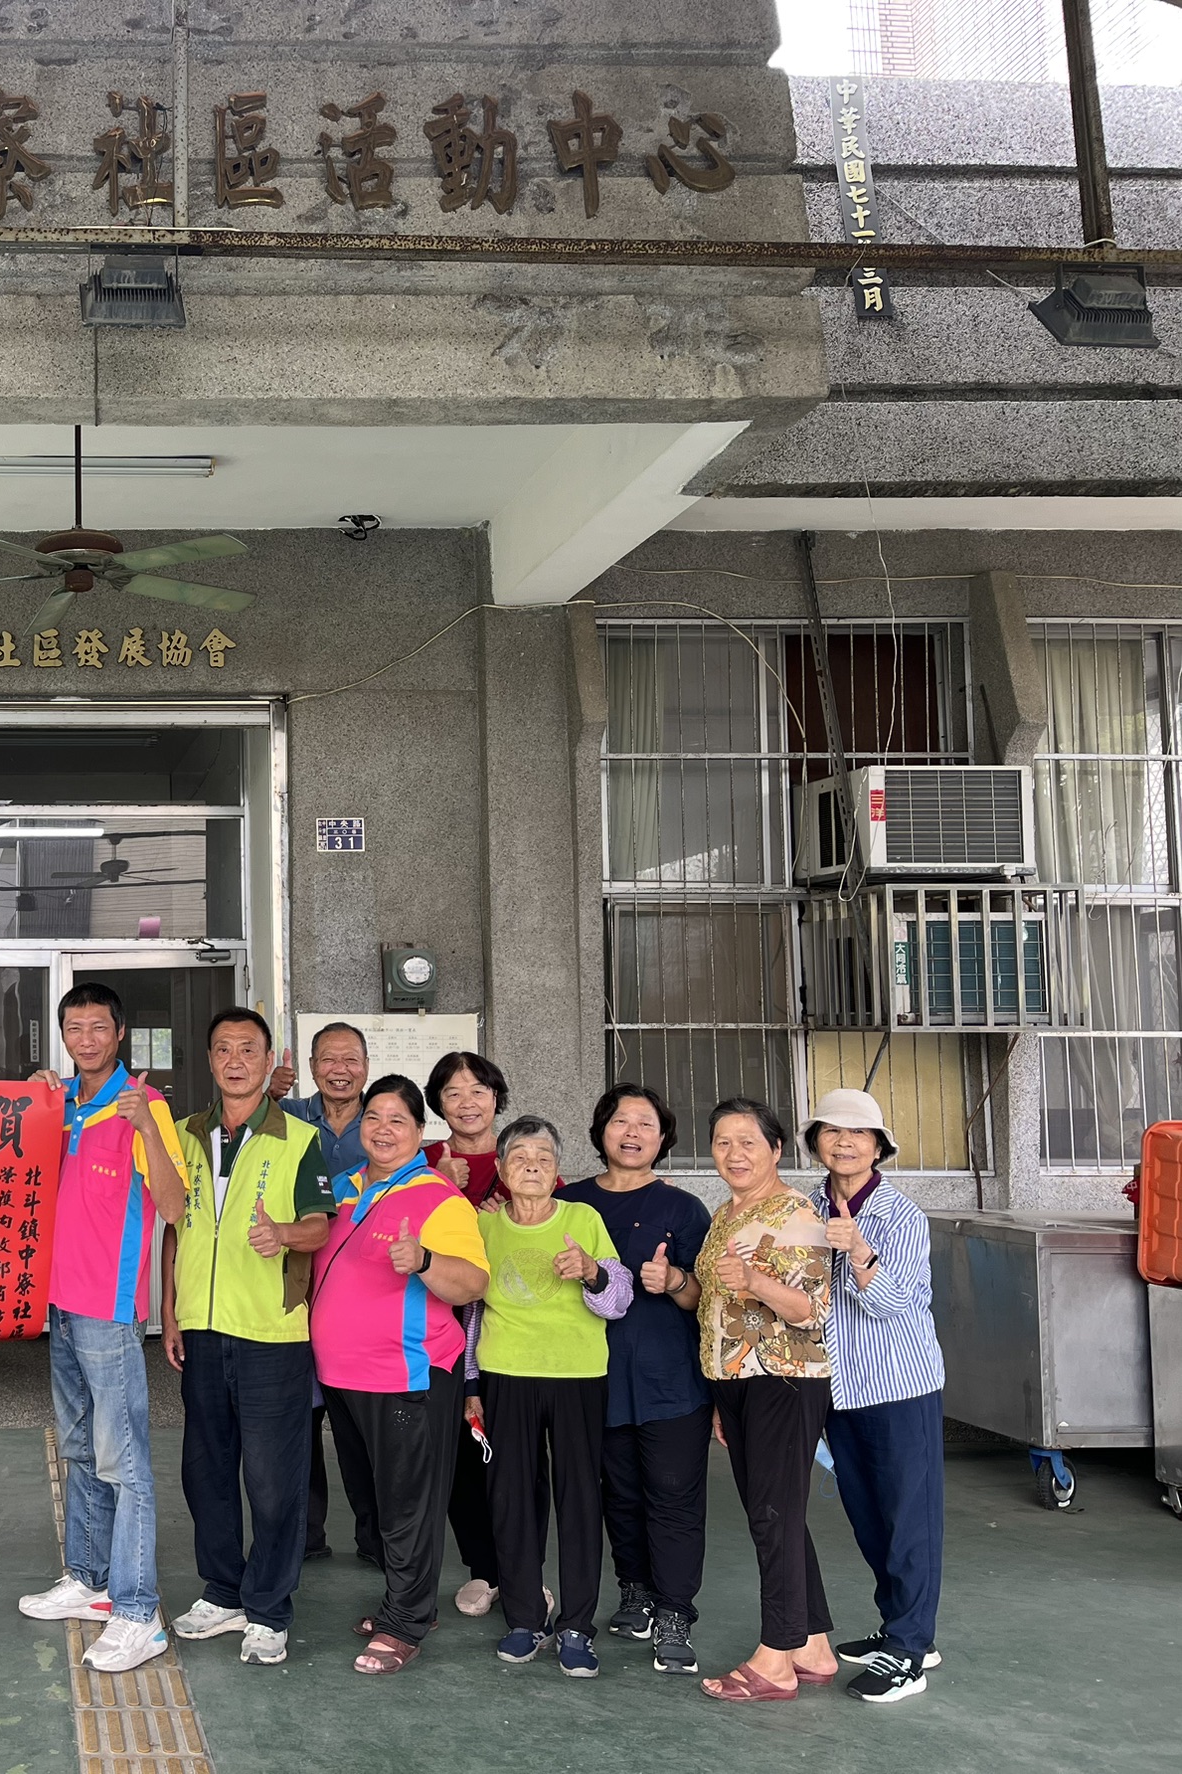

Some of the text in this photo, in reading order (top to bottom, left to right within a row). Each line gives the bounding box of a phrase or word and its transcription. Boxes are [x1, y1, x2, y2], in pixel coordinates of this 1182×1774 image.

[835, 78, 885, 312] 中華民國七十一三月
[871, 793, 885, 819] 三洋
[334, 836, 355, 850] 31
[895, 943, 908, 985] 大同冷氣
